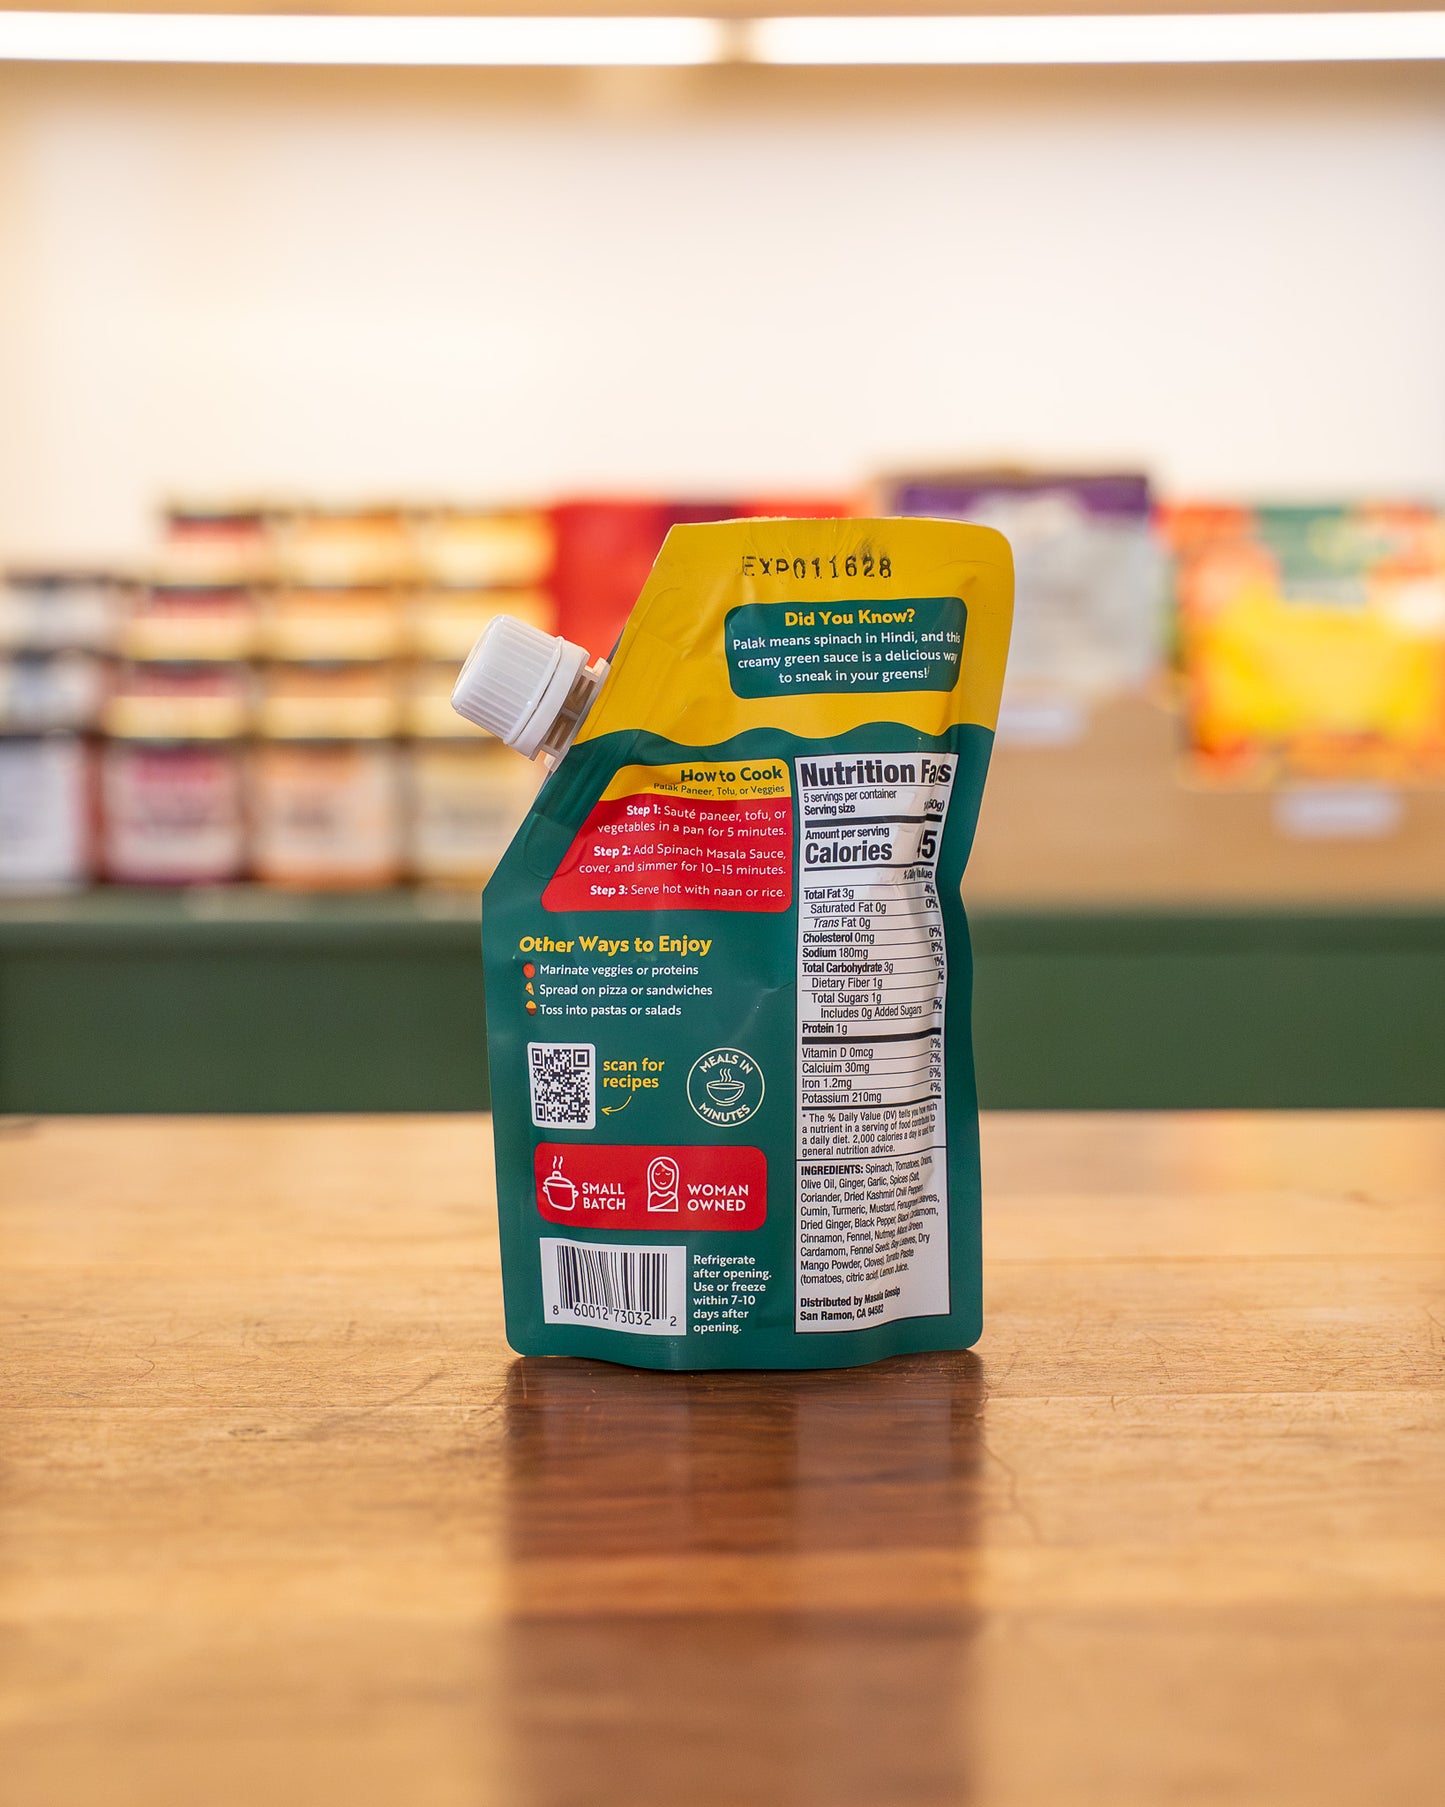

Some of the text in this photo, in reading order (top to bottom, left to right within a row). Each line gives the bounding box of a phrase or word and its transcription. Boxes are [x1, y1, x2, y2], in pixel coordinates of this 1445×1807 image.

[785, 609, 915, 626] Did You Know?
[734, 632, 960, 650] Palak means spinach in Hindi, and this
[738, 650, 958, 668] creamy green sauce is a delicious way
[780, 668, 927, 683] to sneak in your greens!
[680, 766, 783, 782] How to Cook
[801, 760, 915, 787] Nutrition
[681, 786, 714, 796] Paneer,
[717, 786, 736, 796] Tofu,
[750, 785, 784, 795] Veggies
[804, 790, 897, 803] 5 servings per container
[627, 805, 786, 822] Step 1: Sauté paneer, tofu, or
[805, 803, 855, 815] Serving size
[598, 821, 786, 837] vegetables in a pan for 5 minutes.
[805, 826, 889, 840] Amount per serving
[594, 844, 786, 860] Step 2: Add Spinach Masala Sauce,
[805, 841, 892, 864] Calories
[579, 863, 611, 874] cover,
[614, 863, 634, 873] and
[638, 861, 677, 871] simmer
[681, 861, 697, 872] for
[736, 864, 786, 875] minutes.
[590, 884, 786, 897] Step 3: Serve hot with naan or rice.
[804, 889, 854, 899] Total Fat 3g
[811, 902, 886, 914] Saturated Fat 0g
[803, 933, 874, 944] Cholesterol 0mg
[519, 935, 712, 956] Other Ways to Enjoy
[803, 948, 868, 959] Sodium 180mg
[540, 965, 699, 977] Marinate veggies or proteins
[803, 962, 893, 974] Total Carbohydrate 3g
[540, 984, 713, 998] Spread on pizza or sandwiches
[540, 1004, 682, 1017] Toss into pastas or salads
[802, 1023, 847, 1035] Protein 1g
[603, 1058, 665, 1071] scan for
[700, 1054, 753, 1075] MEALS IN
[845, 1063, 869, 1074] 30mg
[603, 1076, 659, 1092] recipes
[802, 1092, 881, 1103] Potassium 210mg
[699, 1102, 750, 1123] MINUTES
[801, 1164, 894, 1175] INGREDIENTS: Spinach,
[582, 1183, 624, 1195] SMALL
[801, 1177, 865, 1190] Olive Oil, Ginger,
[687, 1184, 749, 1197] WOMAN
[801, 1192, 842, 1203] Coriander,
[583, 1198, 625, 1210] BATCH
[687, 1200, 746, 1211] OWNED
[801, 1205, 867, 1217] Cumin, Turmeric,
[693, 1255, 755, 1267] Refrigerate
[800, 1259, 862, 1271] Mango Powder,
[693, 1269, 772, 1281] after opening.
[693, 1282, 766, 1292] Use or freeze
[693, 1296, 755, 1305] within 7-10
[800, 1295, 863, 1307] Distributed by
[693, 1309, 749, 1321] days after
[800, 1310, 854, 1320] San Ramon,
[693, 1323, 741, 1334] opening.
